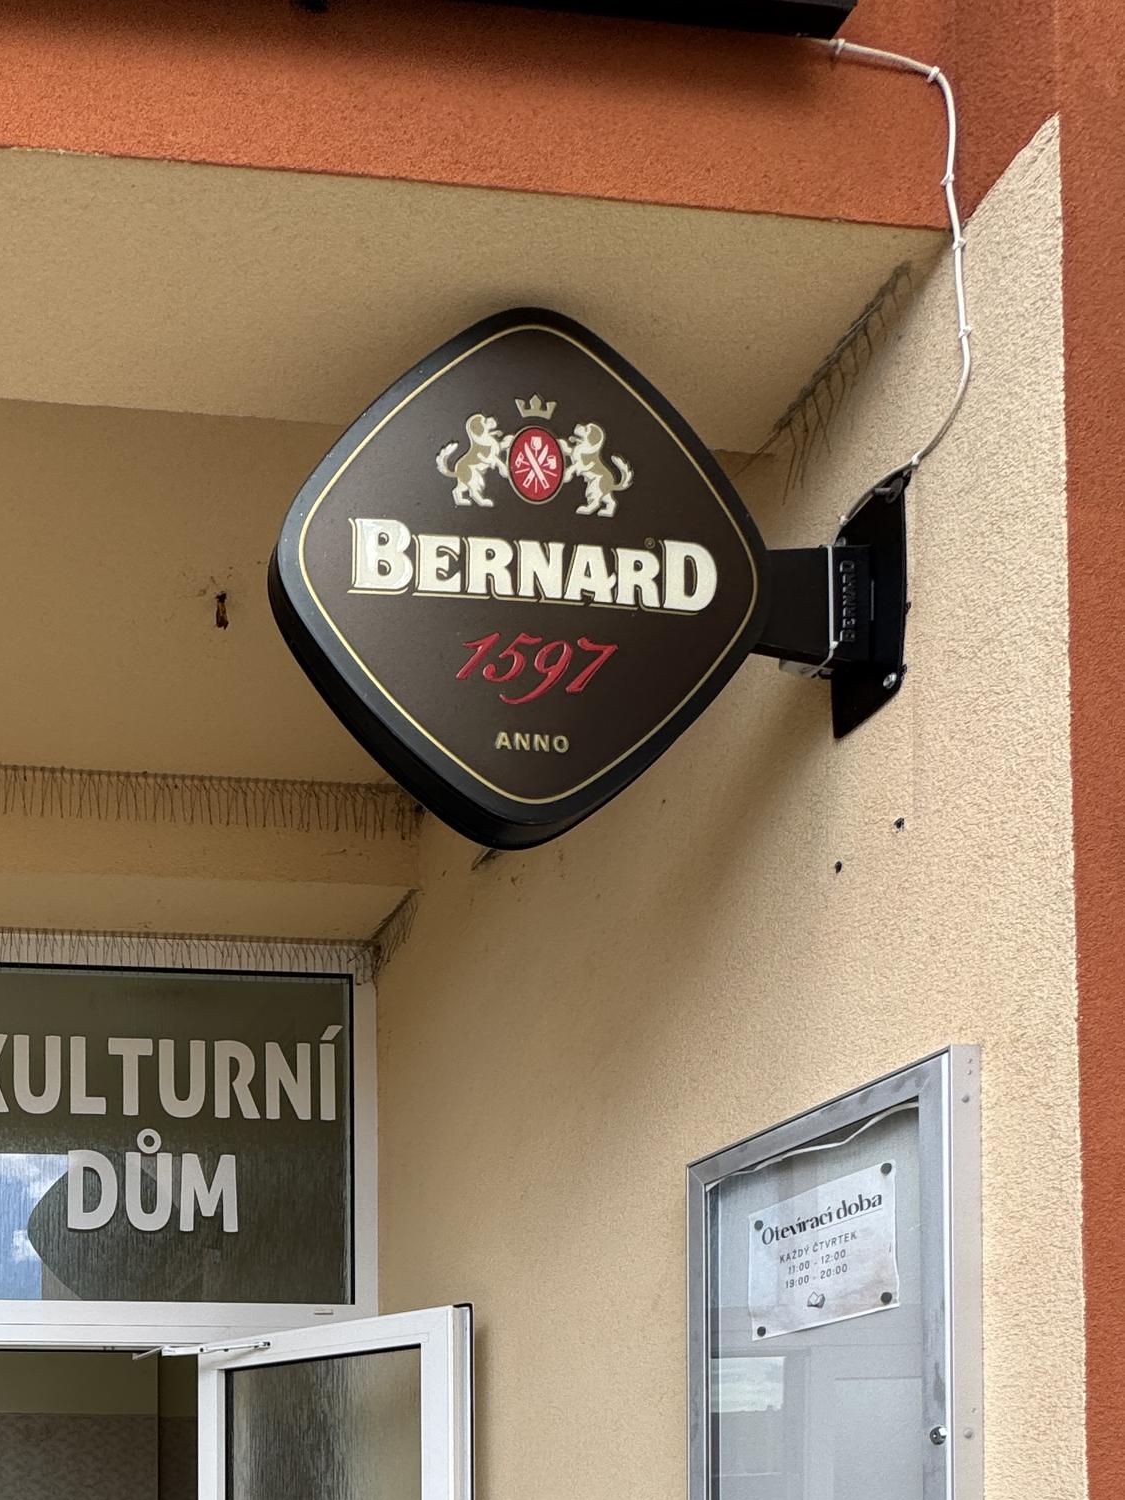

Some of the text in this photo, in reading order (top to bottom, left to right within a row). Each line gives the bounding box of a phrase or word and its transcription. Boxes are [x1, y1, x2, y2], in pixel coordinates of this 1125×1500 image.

[348, 517, 718, 614] BERNARD
[455, 631, 619, 705] 1597
[494, 731, 570, 754] ANNO
[67, 1128, 239, 1233] DŮM
[761, 1193, 883, 1246] Otevírací doba
[779, 1230, 857, 1264] KAŽDÝ ČTVRTEK
[788, 1260, 810, 1275] 11:00
[821, 1249, 847, 1264] 12:00
[785, 1275, 810, 1289] 19:00
[820, 1263, 848, 1278] 20:00
